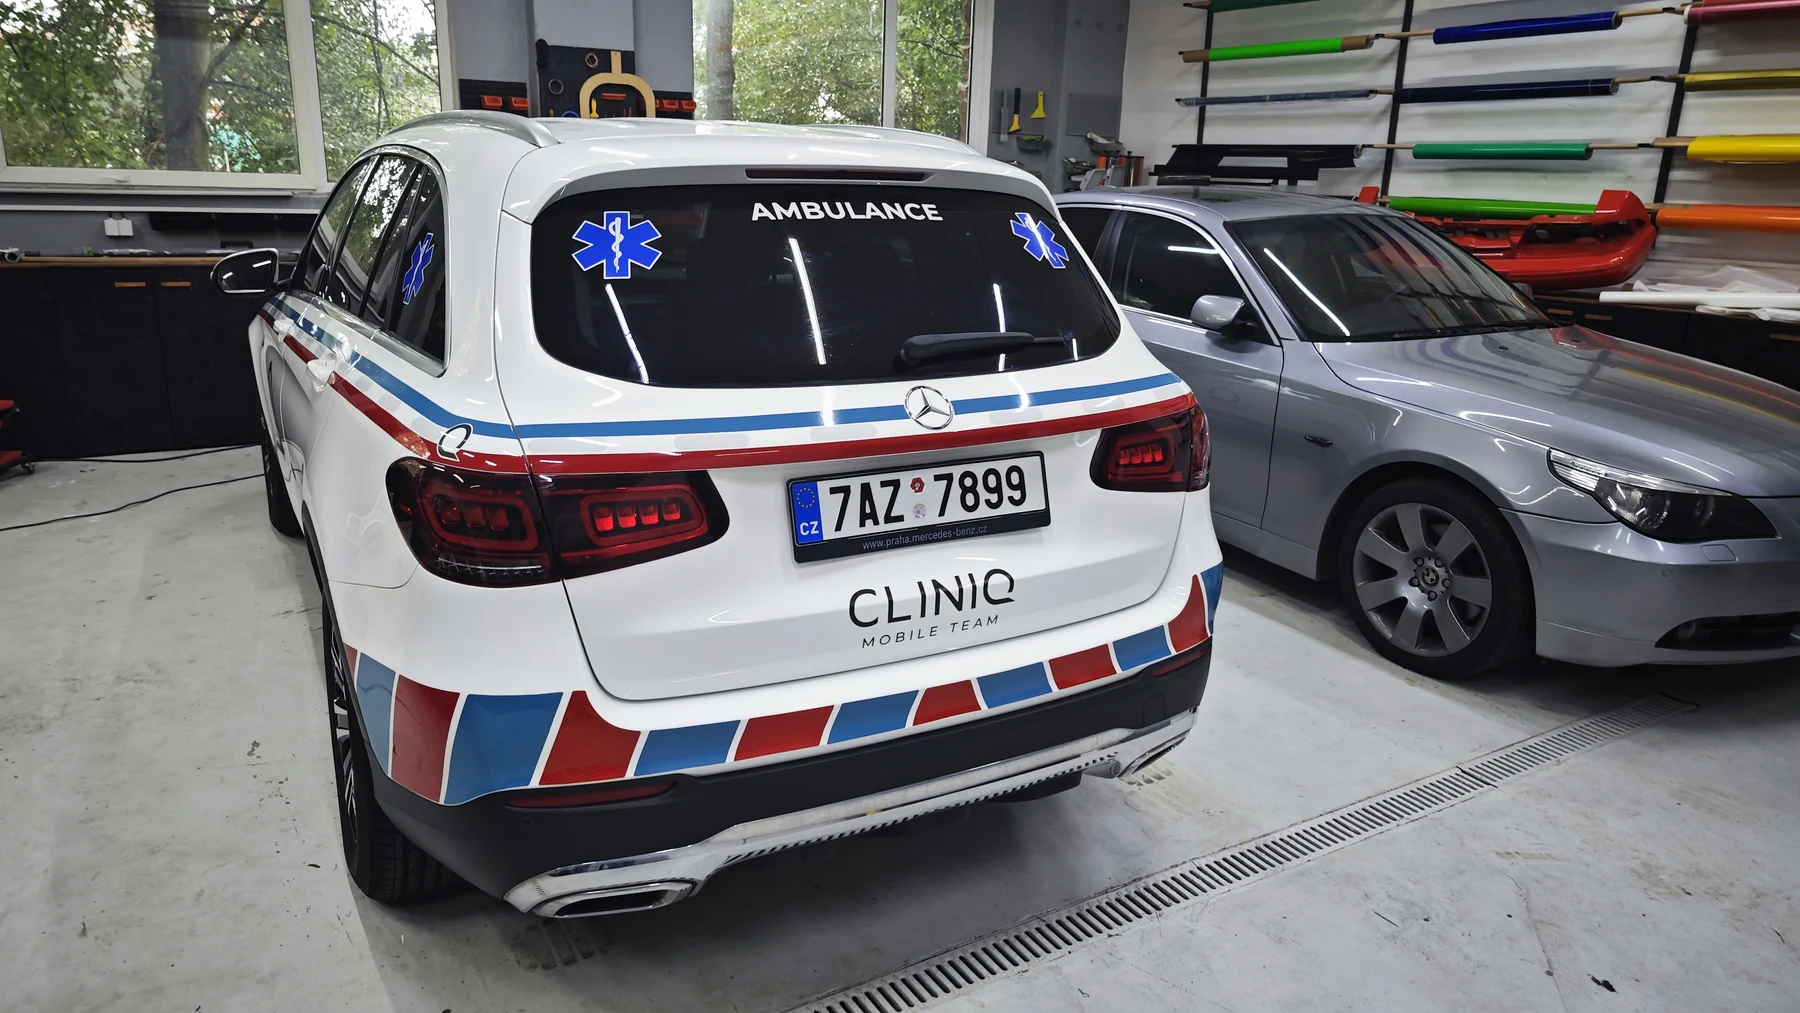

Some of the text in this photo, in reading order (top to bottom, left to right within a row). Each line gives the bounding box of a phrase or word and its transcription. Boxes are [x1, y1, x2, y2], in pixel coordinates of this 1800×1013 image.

[752, 202, 943, 221] AMBULANCE
[829, 465, 1027, 532] 7AZ 7899
[799, 521, 820, 536] CZ
[862, 525, 988, 550] www.praha.mercedes-benz.cz
[849, 568, 1015, 628] CLINIQ
[862, 614, 999, 649] MOBILE TEAM
